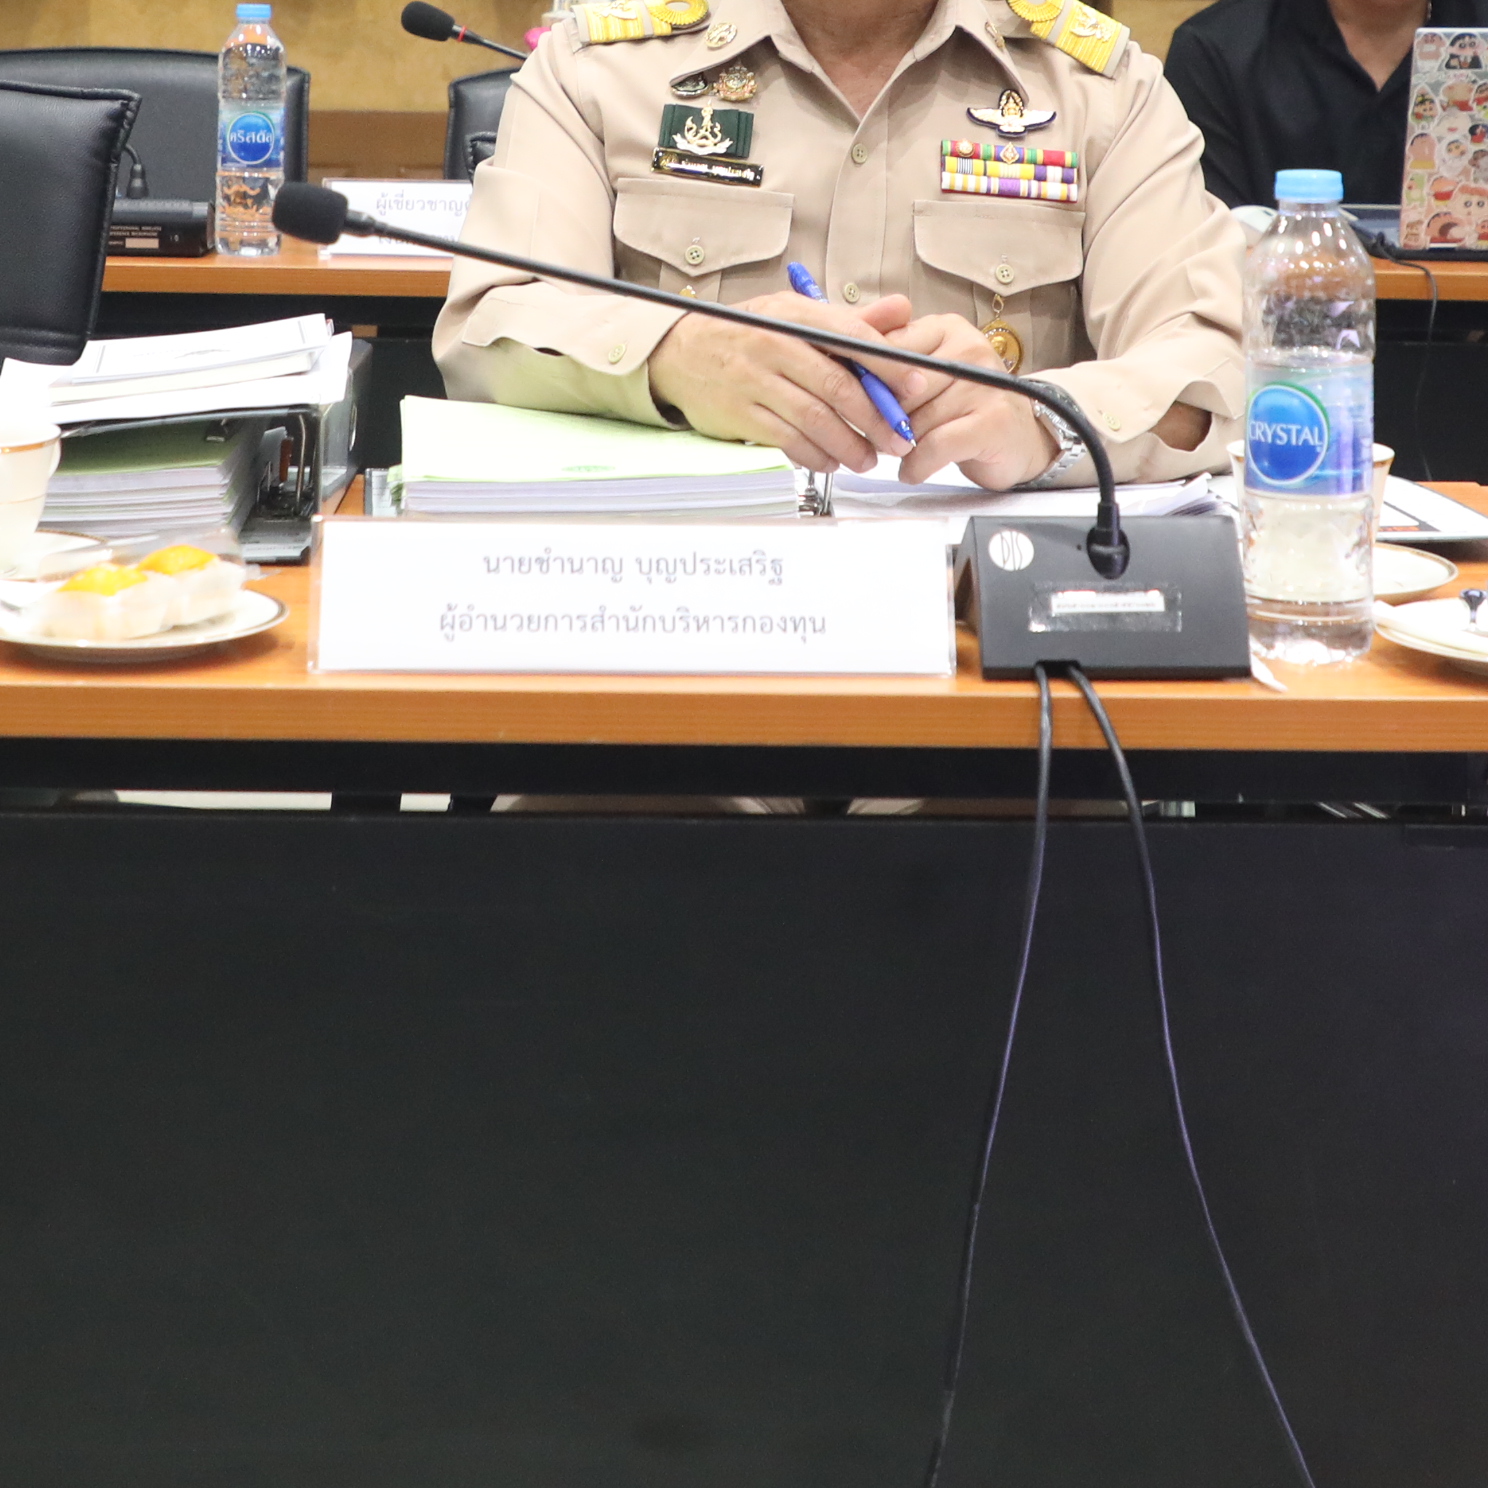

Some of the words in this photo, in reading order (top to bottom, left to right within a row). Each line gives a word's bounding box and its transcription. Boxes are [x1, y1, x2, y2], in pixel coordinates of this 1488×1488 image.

[1249, 420, 1324, 446] CRYSTAL
[483, 546, 624, 583] นายชำนาญ
[635, 548, 785, 586] บุญประเสริฐ
[439, 603, 827, 643] ผู้อำนวยการสำนักบริหารกองทุน
